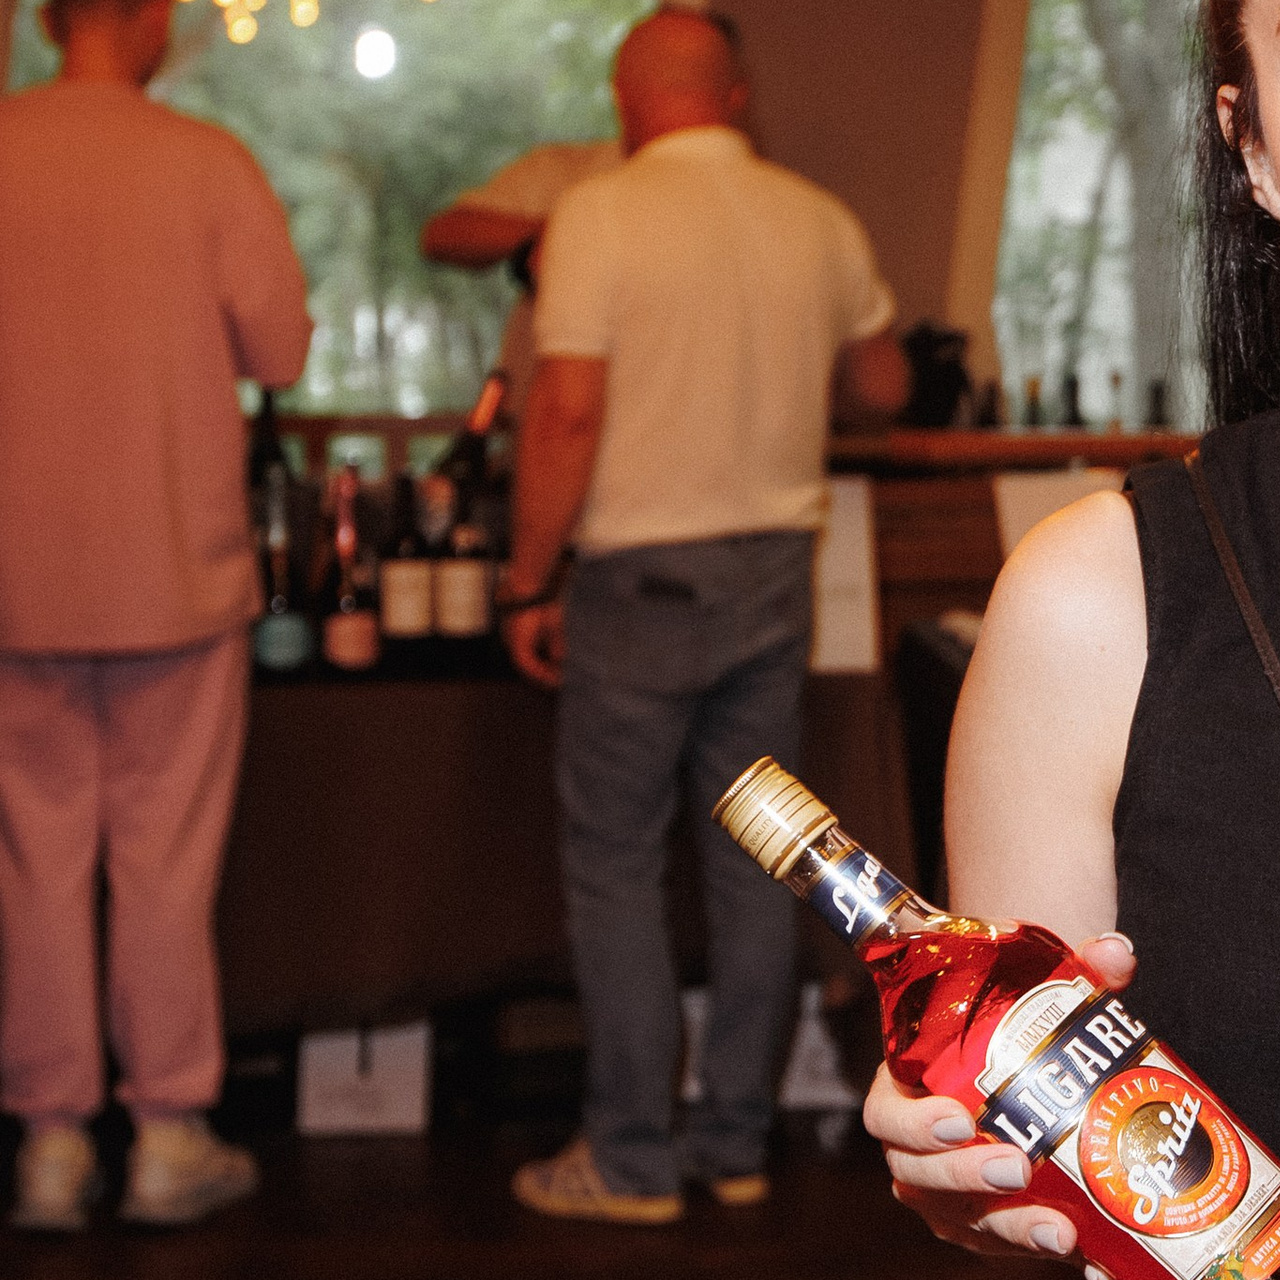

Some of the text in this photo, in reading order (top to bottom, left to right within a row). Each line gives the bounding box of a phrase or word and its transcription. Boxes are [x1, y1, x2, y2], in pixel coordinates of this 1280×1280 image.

[748, 816, 773, 846] QUALITY
[1014, 1002, 1066, 1053] MMXVIII
[993, 999, 1147, 1153] LIGARE
[1090, 1076, 1159, 1179] APERITIVO
[1128, 1092, 1202, 1225] Spritz
[1203, 1183, 1270, 1256] BEVANDA DA DESSERT
[1250, 1237, 1278, 1266] ANTICA
